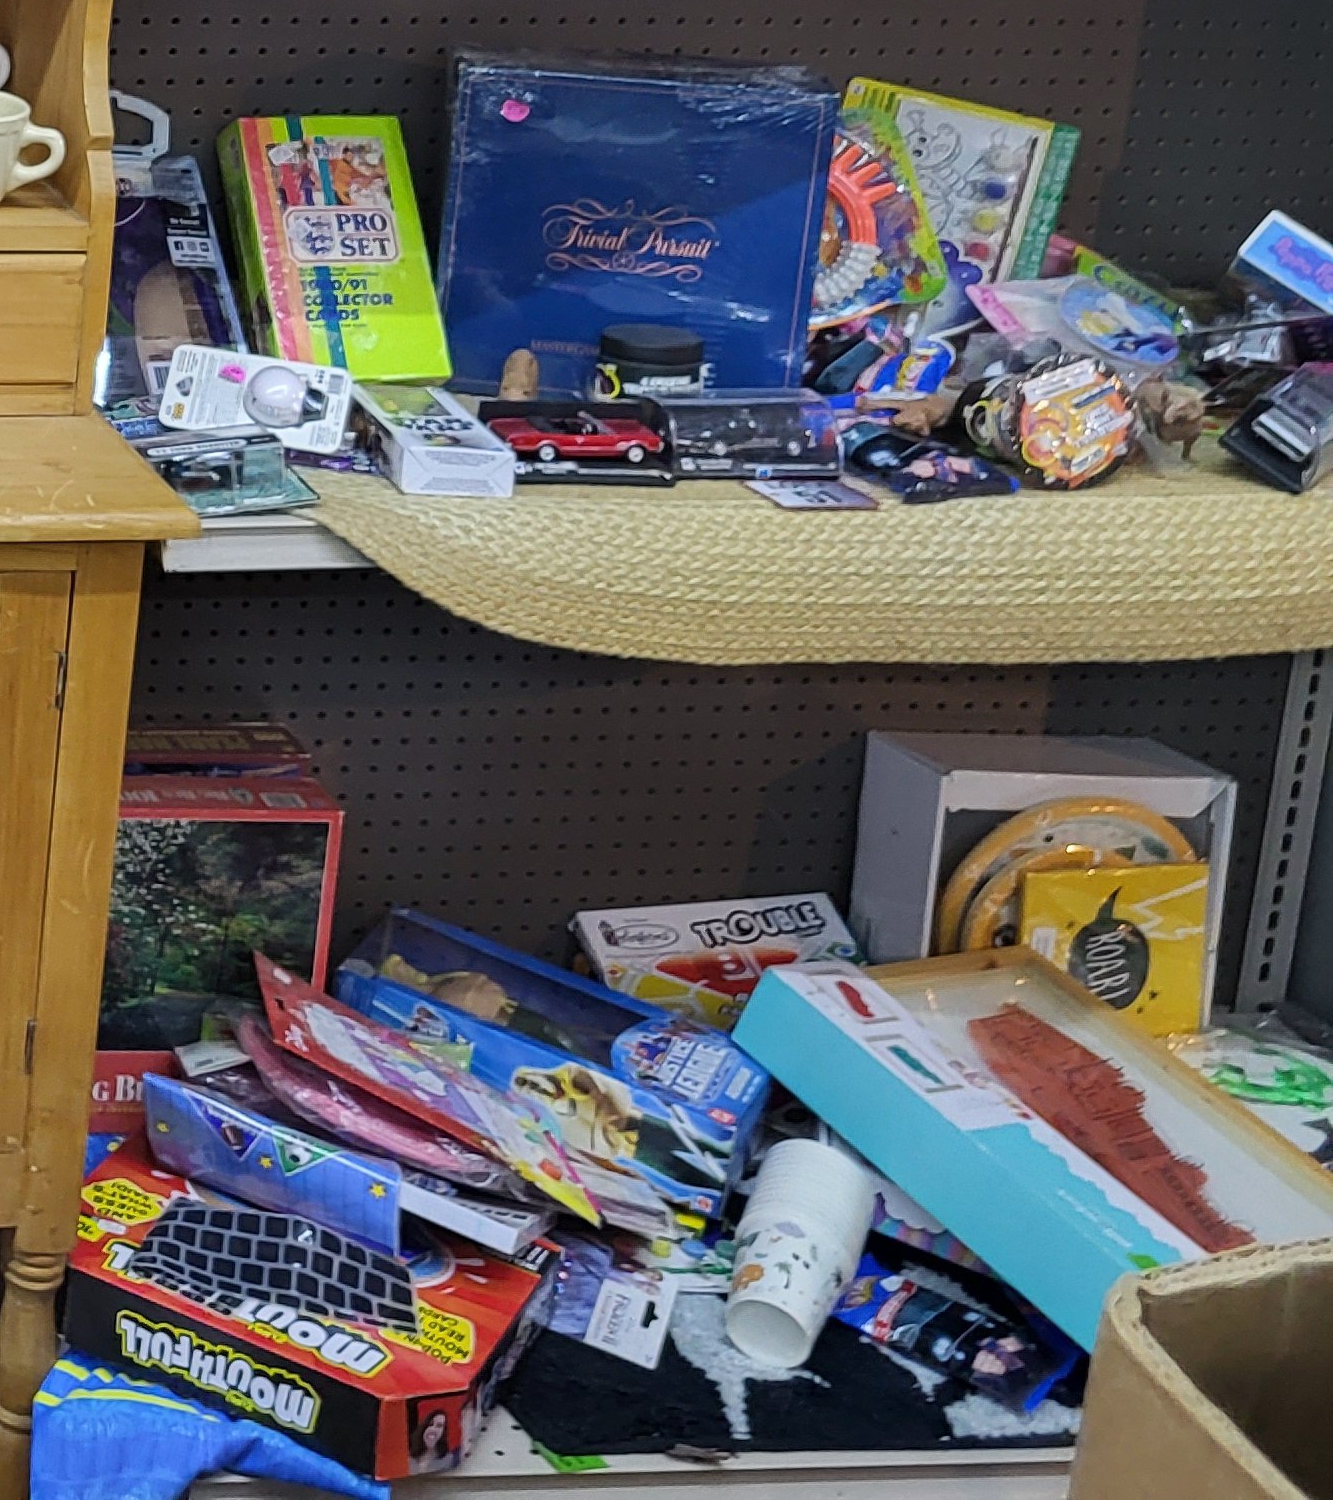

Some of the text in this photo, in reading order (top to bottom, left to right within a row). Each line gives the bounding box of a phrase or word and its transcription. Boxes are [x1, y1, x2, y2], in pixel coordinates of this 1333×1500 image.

[334, 213, 388, 232] PRO
[542, 215, 712, 258] Trivial Pursuit
[338, 237, 390, 257] SET
[689, 900, 825, 950] TROUBLE
[121, 1317, 316, 1430] MOUTHFULL
